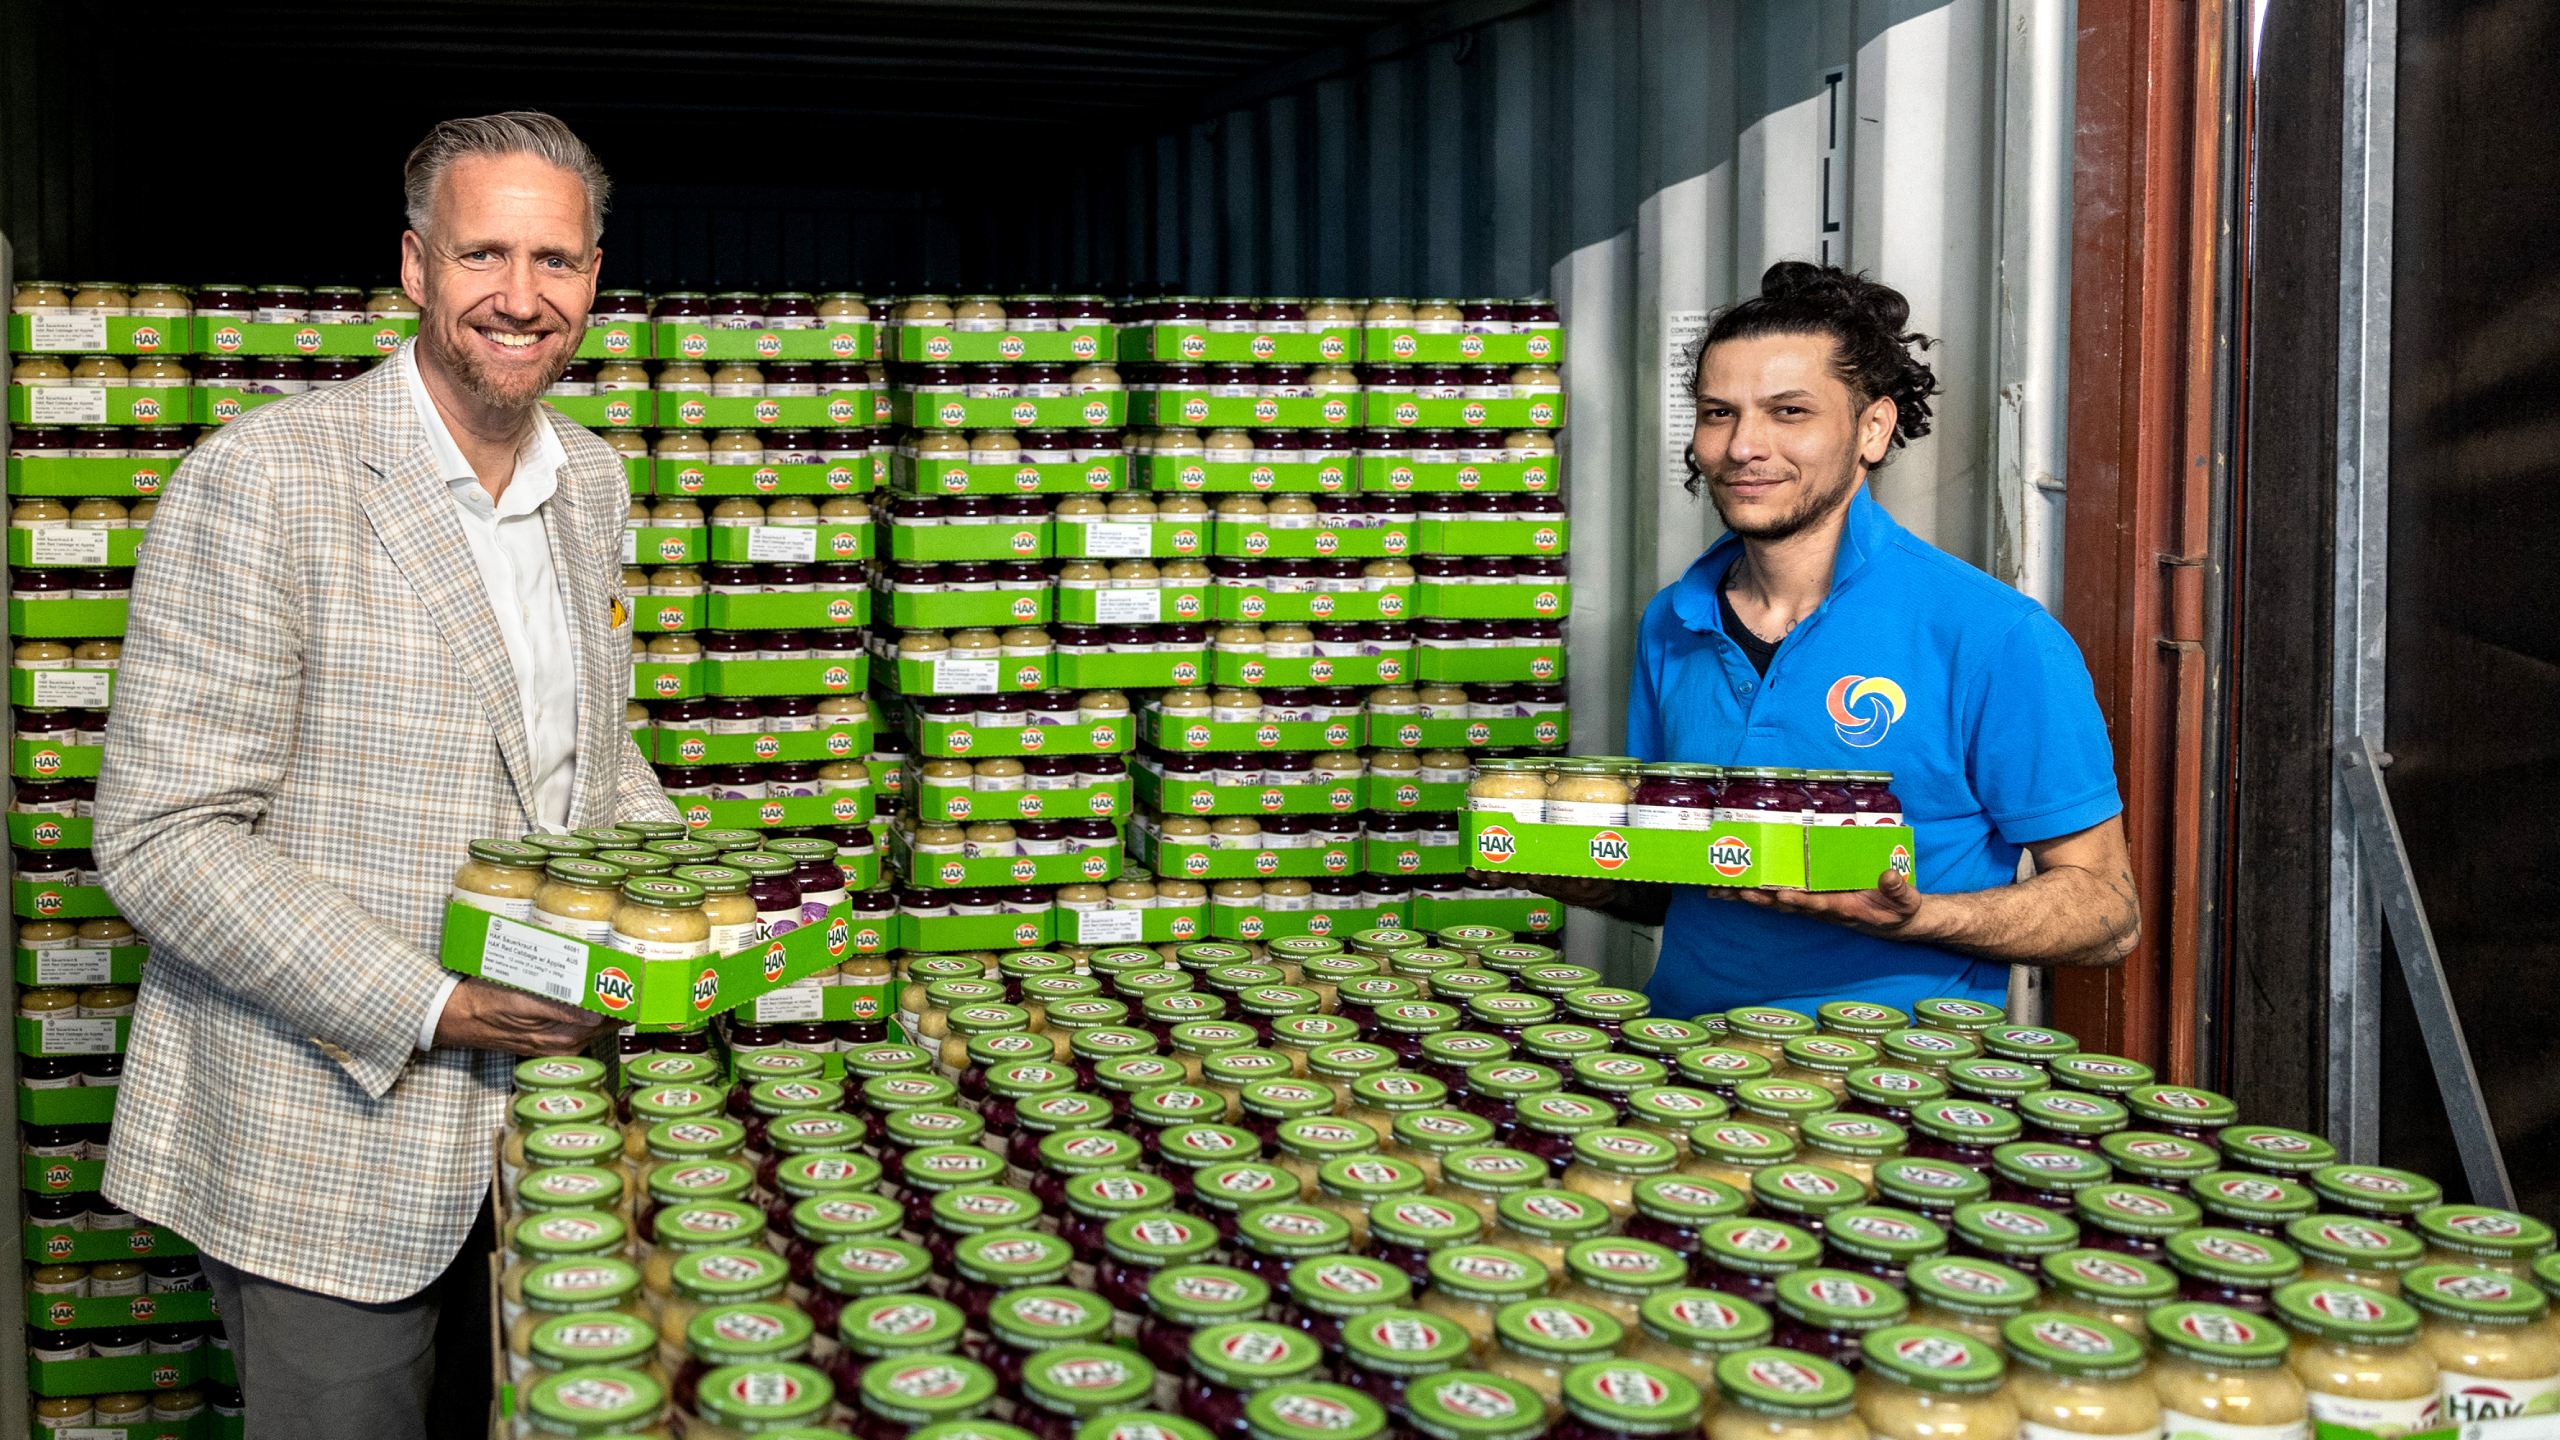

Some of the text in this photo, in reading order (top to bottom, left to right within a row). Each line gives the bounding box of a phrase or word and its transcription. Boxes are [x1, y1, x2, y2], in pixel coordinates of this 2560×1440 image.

[134, 333, 160, 345] HAK
[217, 333, 241, 345] HAK
[297, 334, 321, 346] HAK
[606, 336, 630, 347] HAK
[758, 340, 781, 351] HAK
[832, 340, 855, 351] HAK
[928, 342, 951, 353] HAK
[1322, 342, 1343, 353] HAK
[1393, 341, 1416, 351] HAK
[1461, 341, 1482, 352] HAK
[1528, 342, 1549, 352] HAK
[134, 404, 160, 416] HAK
[608, 407, 632, 418] HAK
[756, 406, 779, 417] HAK
[830, 405, 853, 416] HAK
[1014, 408, 1037, 419] HAK
[1324, 406, 1345, 417] HAK
[1464, 409, 1485, 419] HAK
[1531, 409, 1552, 419] HAK
[134, 475, 160, 487] HAK
[829, 473, 852, 484] HAK
[945, 475, 968, 486] HAK
[1017, 474, 1040, 485] HAK
[1182, 472, 1205, 483] HAK
[1252, 473, 1273, 483] HAK
[1391, 473, 1412, 484] HAK
[1525, 473, 1546, 483] HAK
[833, 538, 857, 550] HAK
[1245, 538, 1268, 548] HAK
[1384, 537, 1407, 548] HAK
[1535, 534, 1556, 544] HAK
[661, 544, 684, 555] HAK
[1013, 603, 1036, 615] HAK
[1312, 601, 1333, 611] HAK
[1381, 599, 1402, 610] HAK
[830, 605, 854, 617] HAK
[1311, 666, 1332, 676] HAK
[1532, 662, 1553, 672] HAK
[1018, 672, 1041, 683] HAK
[1174, 668, 1195, 678] HAK
[657, 679, 681, 690] HAK
[1092, 732, 1115, 742] HAK
[1257, 731, 1280, 741] HAK
[1400, 730, 1421, 740] HAK
[1468, 728, 1489, 739] HAK
[948, 735, 971, 747] HAK
[681, 745, 704, 755] HAK
[756, 742, 780, 752] HAK
[34, 756, 60, 768] HAK
[1191, 796, 1214, 806] HAK
[1330, 794, 1353, 804] HAK
[948, 802, 971, 813] HAK
[1020, 800, 1043, 811] HAK
[761, 808, 784, 818] HAK
[35, 828, 61, 839] HAK
[1478, 836, 1515, 853] HAK
[1590, 840, 1628, 859] HAK
[1325, 856, 1346, 866] HAK
[1710, 847, 1752, 866] HAK
[1186, 859, 1209, 869] HAK
[1256, 857, 1277, 868] HAK
[1891, 856, 1910, 872] HAK
[1013, 865, 1036, 876] HAK
[36, 897, 62, 909] HAK
[1529, 914, 1550, 924] HAK
[1173, 922, 1194, 933] HAK
[1241, 922, 1262, 932] HAK
[489, 932, 501, 941] HAK
[502, 936, 533, 950] Sauerkraut
[828, 925, 848, 949] HAK
[856, 935, 879, 946] HAK
[488, 940, 501, 950] HAK
[501, 944, 513, 953] Red
[513, 948, 538, 961] Cabbage
[546, 958, 566, 970] Apples
[1405, 952, 1452, 962] HAK
[1494, 949, 1541, 958] HAK
[566, 957, 579, 966] AUS
[764, 950, 786, 973] HAK
[1444, 973, 1493, 984] HAK
[1536, 969, 1584, 980] HAK
[596, 974, 634, 1002] HAK
[1038, 979, 1085, 989] HAK
[694, 978, 718, 1002] HAK
[853, 1000, 878, 1012] HAK
[964, 1009, 1013, 1021] HAK
[1188, 1026, 1241, 1040] HAK
[1088, 1032, 1140, 1046] HAK
[753, 1054, 806, 1068] HAK
[1969, 1065, 2028, 1081] HAK
[2070, 1061, 2134, 1076] HAK
[1258, 1086, 1316, 1100] HAK
[1756, 1086, 1814, 1102] HAK
[786, 1118, 847, 1136] HAK
[1298, 1126, 1358, 1143] HAK
[46, 1171, 72, 1182] HAK
[679, 1210, 742, 1232] HAK
[47, 1241, 73, 1252] HAK
[130, 1236, 154, 1247] HAK
[49, 1307, 75, 1319] HAK
[131, 1302, 155, 1314] HAK
[153, 1371, 179, 1381] HAK
[2450, 1396, 2524, 1422] HAK
